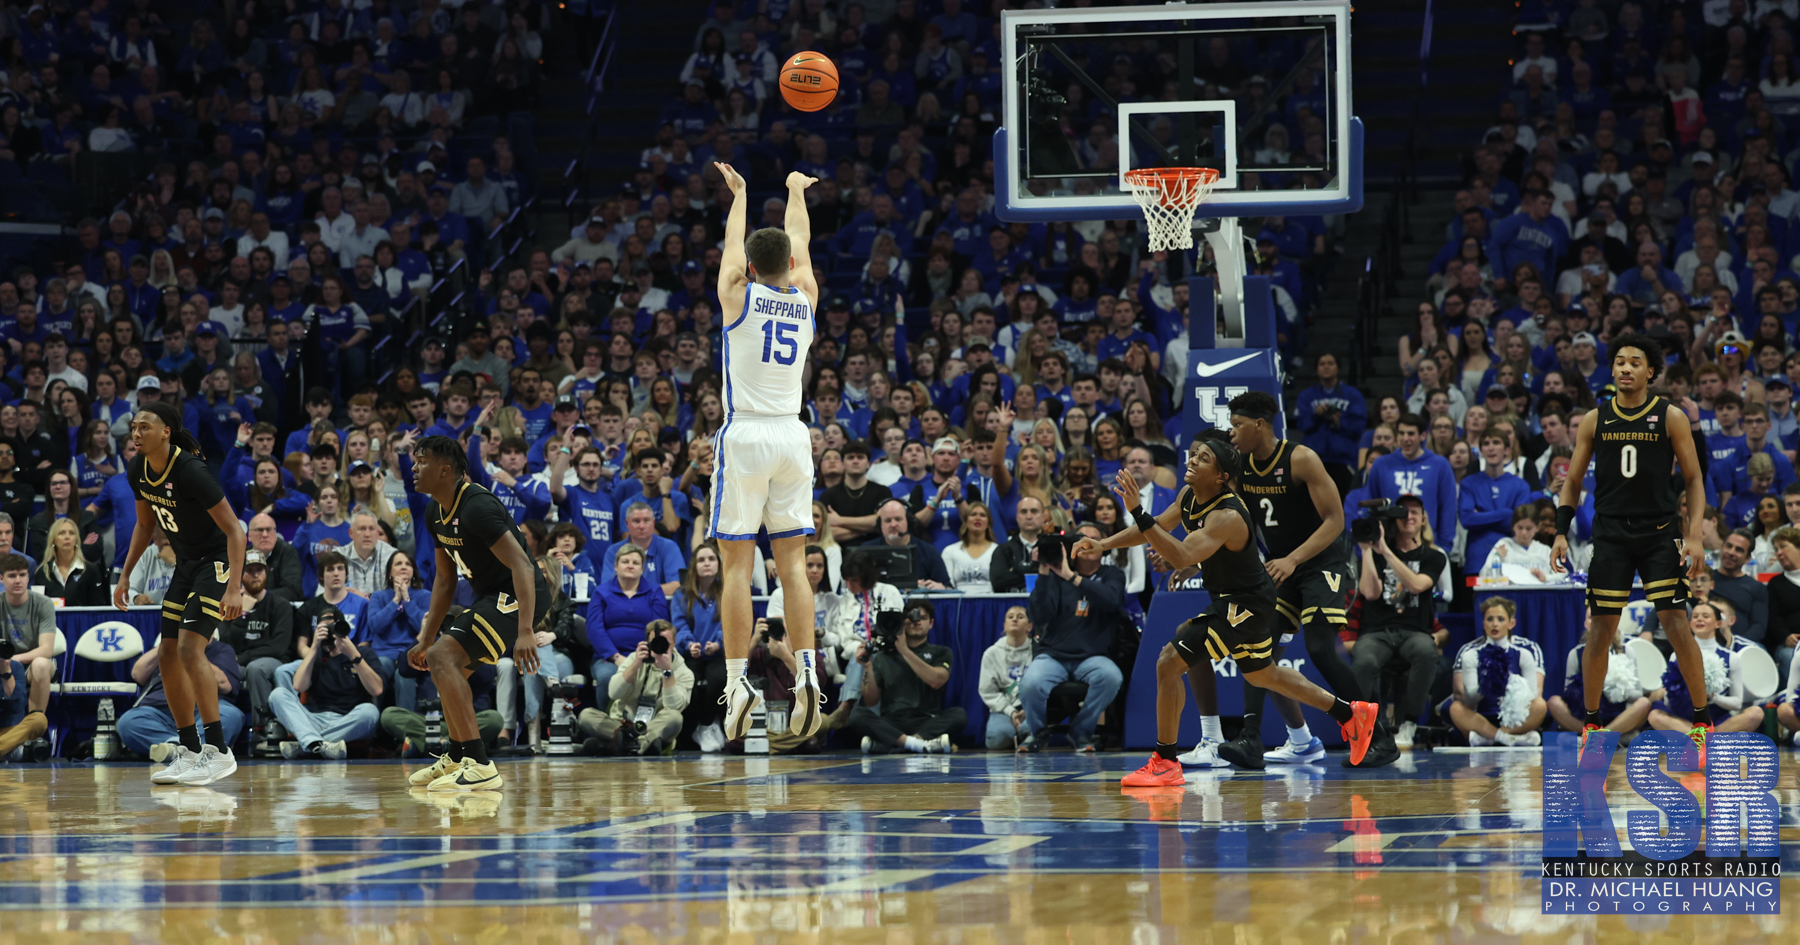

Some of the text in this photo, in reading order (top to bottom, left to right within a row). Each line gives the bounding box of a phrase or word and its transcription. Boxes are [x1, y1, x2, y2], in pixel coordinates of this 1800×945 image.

[754, 297, 808, 320] SHEPPARD
[761, 319, 799, 366] 15
[1602, 432, 1659, 442] VANDERBILT
[1620, 444, 1637, 479] 0
[1242, 482, 1287, 494] VANDERBILT
[1394, 470, 1423, 496] UK
[151, 504, 180, 533] 13
[582, 507, 613, 521] KENTUCKY
[1259, 497, 1279, 527] 2
[590, 520, 610, 541] 23
[1321, 570, 1342, 593] V
[1227, 602, 1255, 628] V
[96, 628, 124, 652] UK
